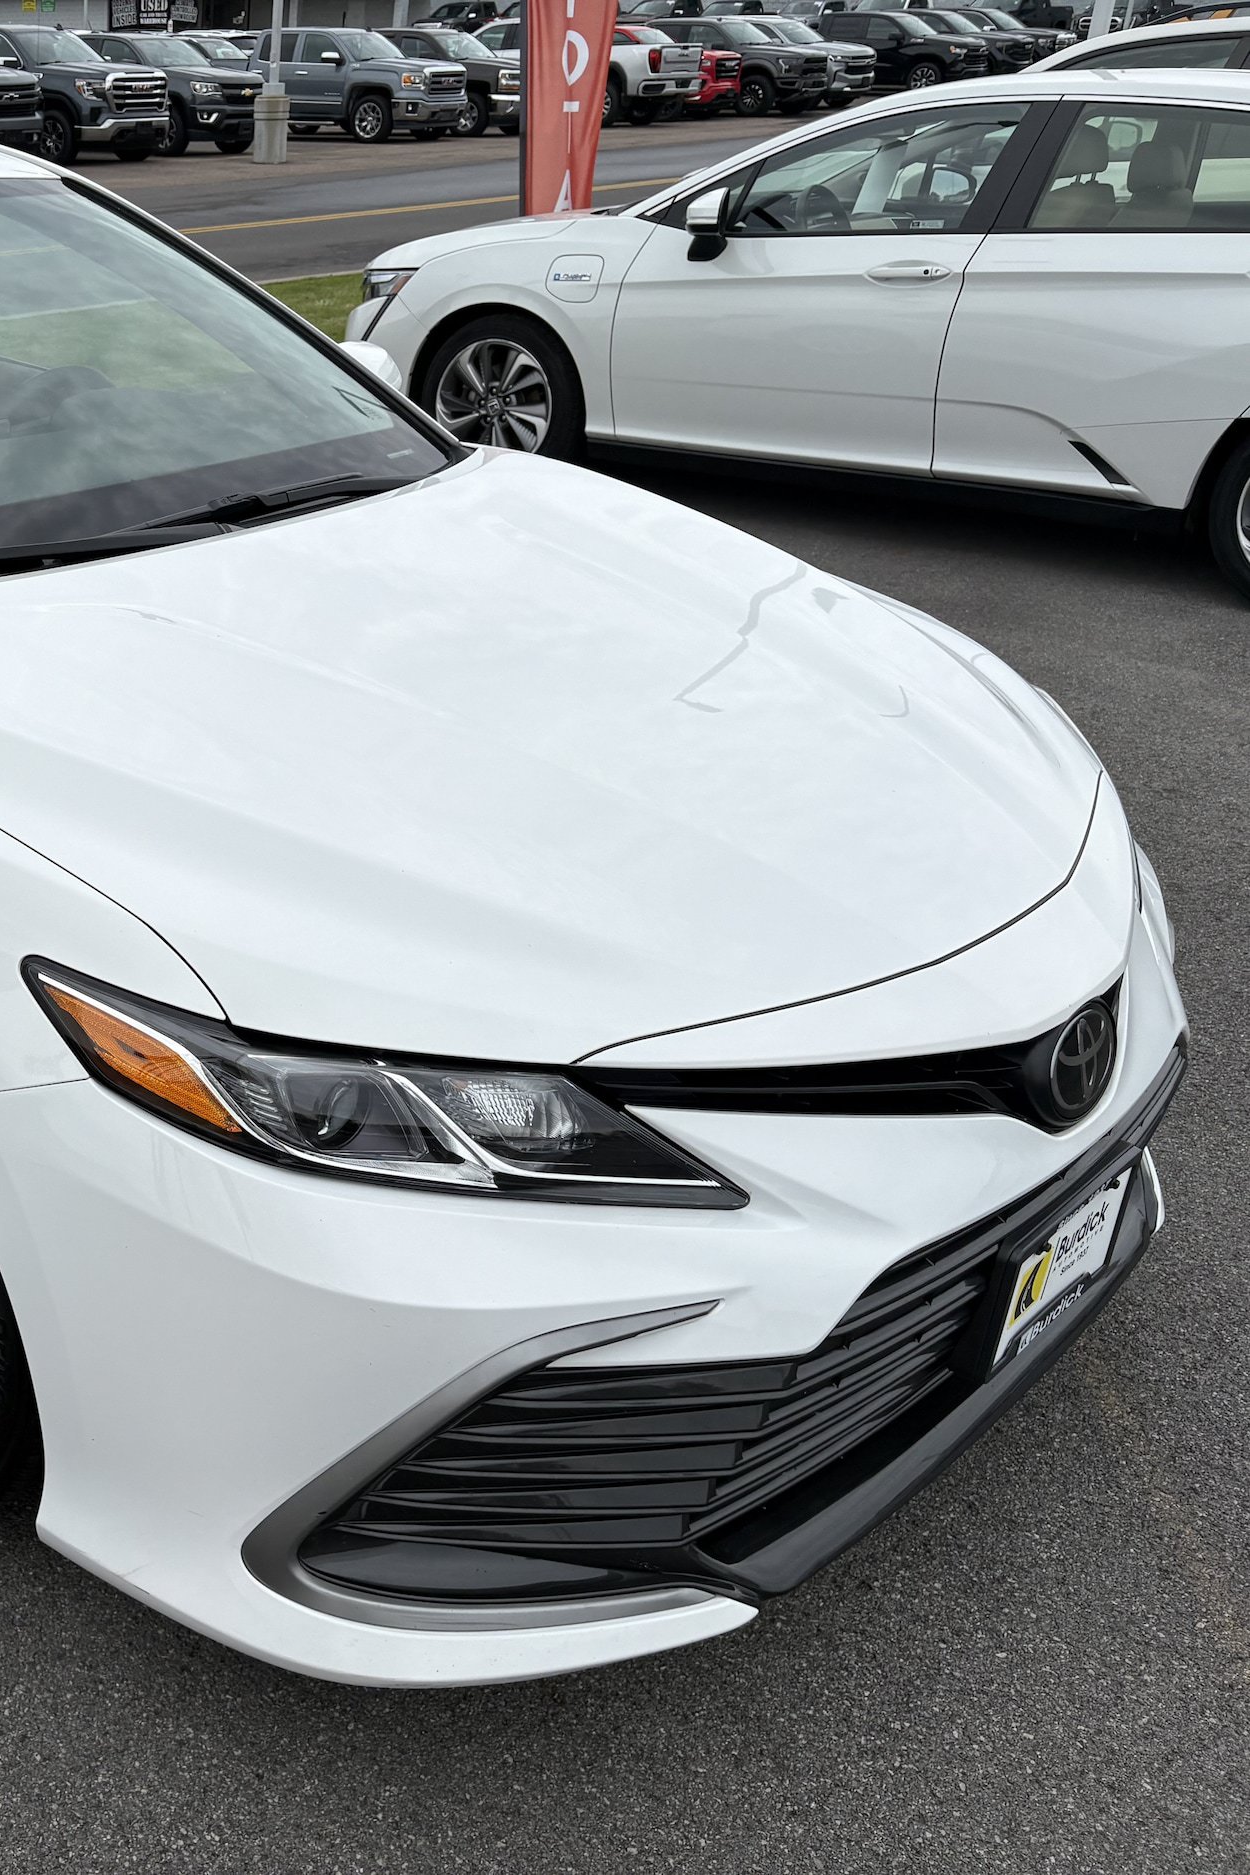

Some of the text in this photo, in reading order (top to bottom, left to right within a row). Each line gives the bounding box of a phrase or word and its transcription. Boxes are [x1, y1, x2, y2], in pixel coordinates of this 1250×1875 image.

[112, 13, 138, 28] INSIDE
[141, 0, 168, 11] USED
[1055, 1201, 1110, 1263] Burdick
[1031, 1283, 1085, 1341] Burdick
